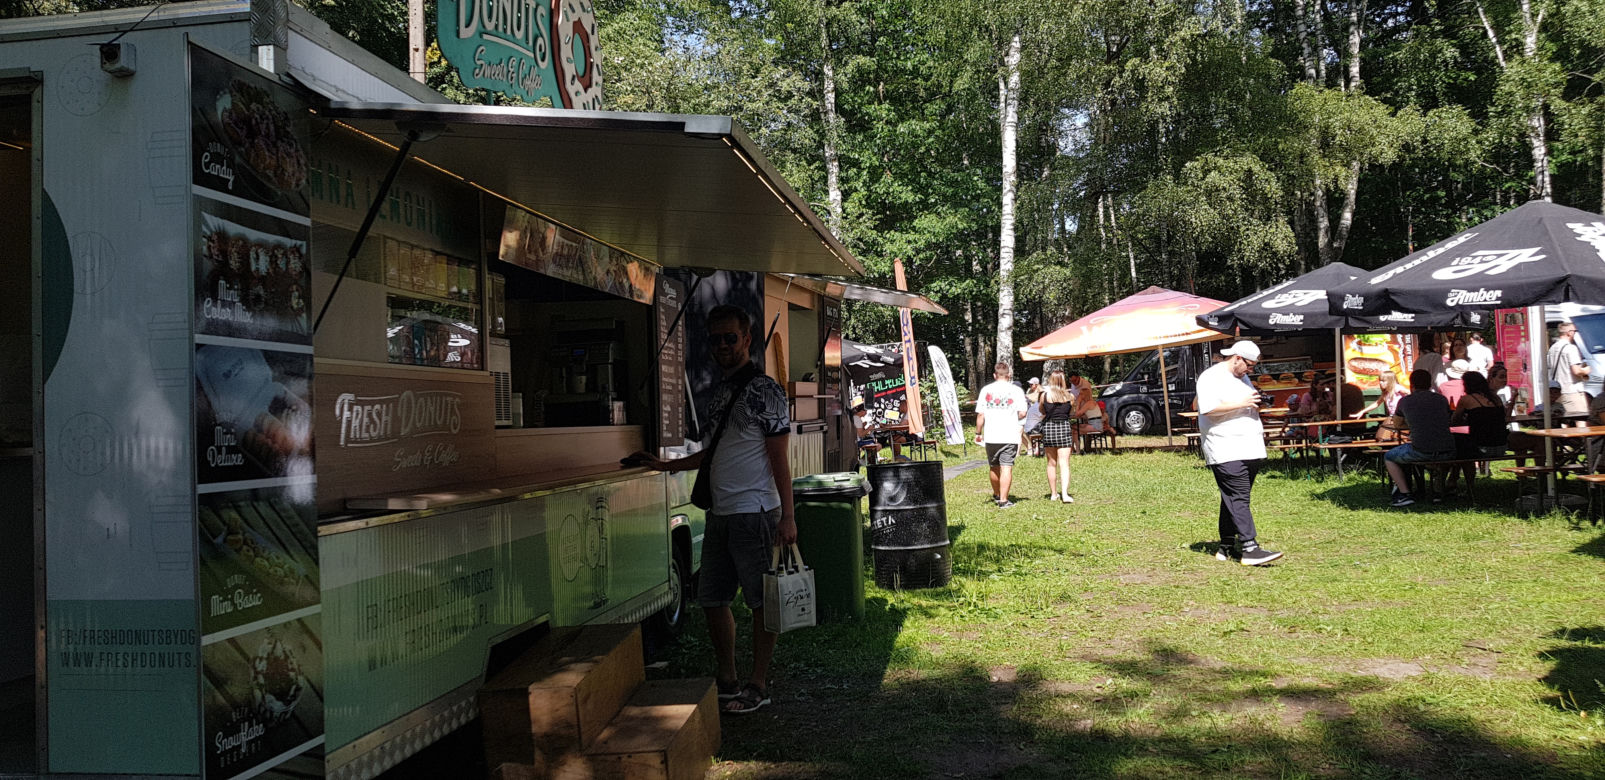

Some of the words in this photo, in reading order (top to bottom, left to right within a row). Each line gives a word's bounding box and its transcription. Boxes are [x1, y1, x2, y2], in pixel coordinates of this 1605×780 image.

[458, 0, 549, 69] DONUTS
[474, 45, 506, 80] Sweets
[507, 56, 516, 85] &
[518, 58, 543, 96] Coffee
[202, 152, 235, 190] Candy
[217, 280, 240, 301] Mini
[1445, 287, 1502, 307] Amber
[203, 297, 234, 320] Color
[234, 302, 254, 323] Mix
[1269, 313, 1304, 325] Amber
[335, 393, 393, 447] FRESH
[397, 390, 461, 436] DONUTS
[214, 426, 237, 446] Mini
[207, 446, 244, 467] Deluxe
[392, 447, 422, 471] Sweets
[423, 444, 433, 469] &
[210, 594, 234, 617] Mini
[234, 588, 263, 610] Basic
[215, 718, 265, 755] Snowflake
